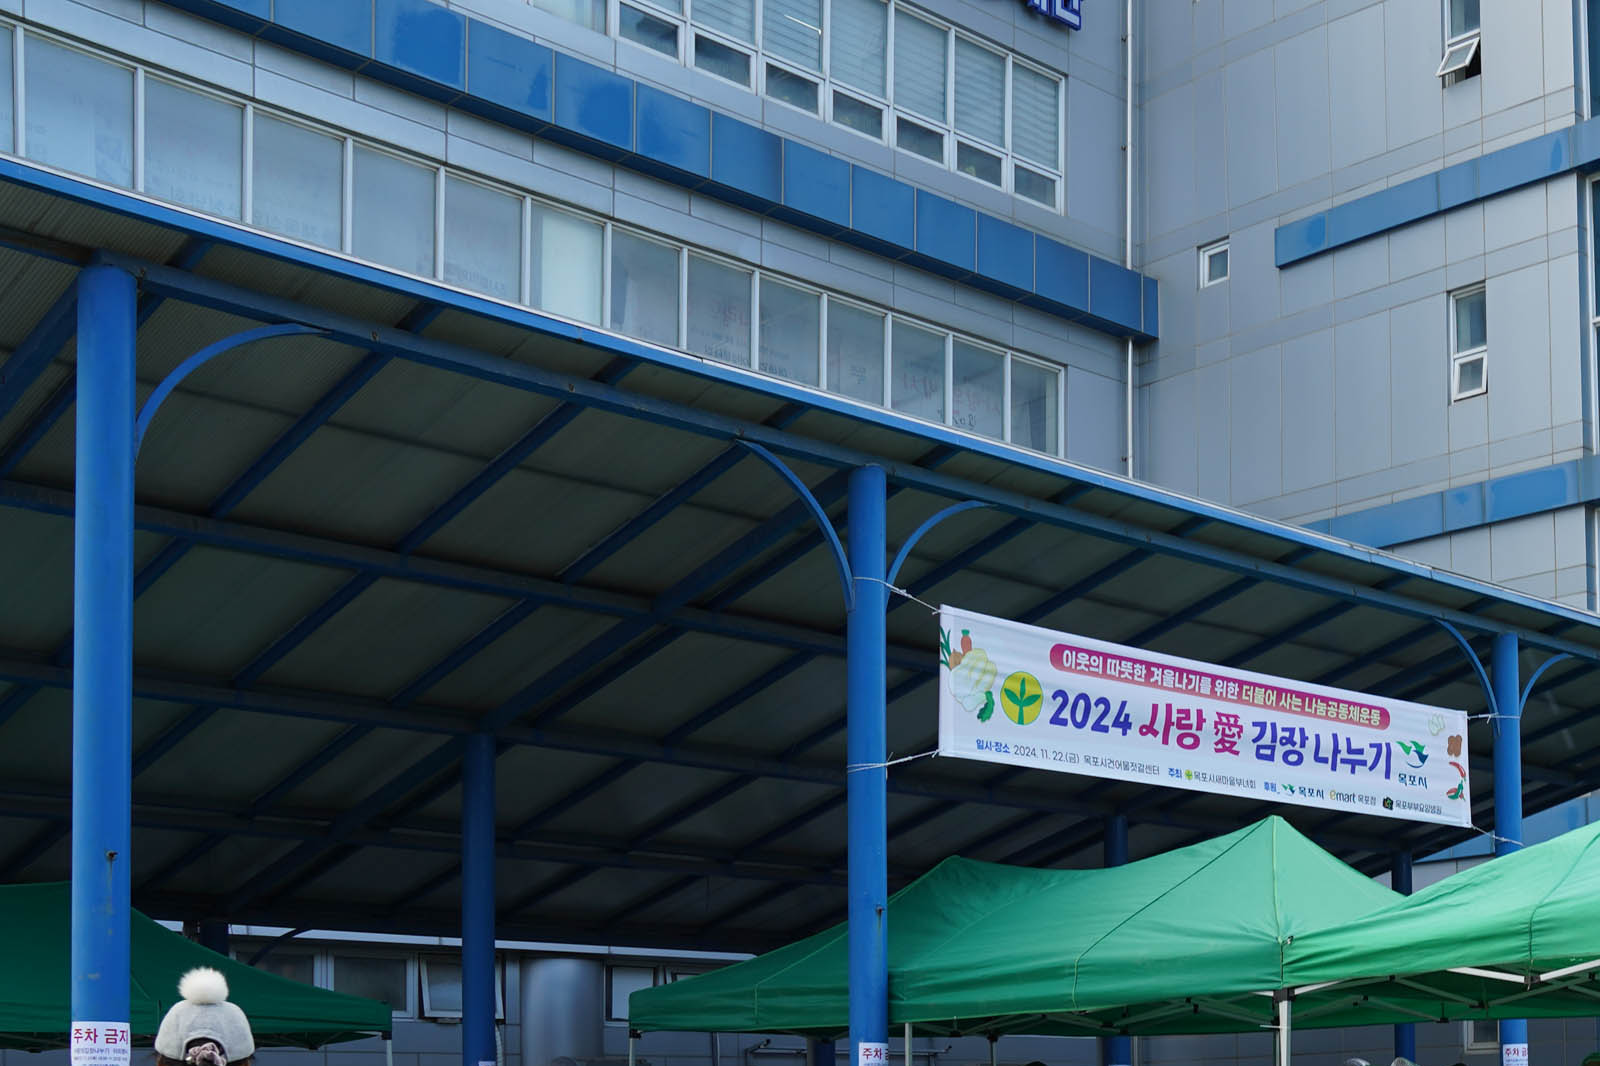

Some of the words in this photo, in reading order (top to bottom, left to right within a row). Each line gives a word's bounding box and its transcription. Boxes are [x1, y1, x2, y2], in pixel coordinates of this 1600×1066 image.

[1063, 650, 1103, 674] 이웃의
[1107, 658, 1147, 682] 따뜻한
[1150, 666, 1212, 695] 겨울나기를
[1215, 680, 1240, 700] 위한
[1242, 684, 1277, 707] 더불어
[1279, 692, 1302, 712] 사는
[1304, 697, 1381, 726] 나눔공동체운동
[1049, 689, 1132, 736] 2024
[1138, 703, 1206, 750] 사랑
[1213, 711, 1243, 756] 愛
[1251, 721, 1309, 767] 김장
[1398, 773, 1428, 790] 목포시
[1298, 786, 1325, 800] 목포시
[1329, 790, 1356, 805] emart
[74, 1028, 99, 1044] 주차
[104, 1028, 129, 1045] 금지
[863, 1048, 882, 1060] 주차
